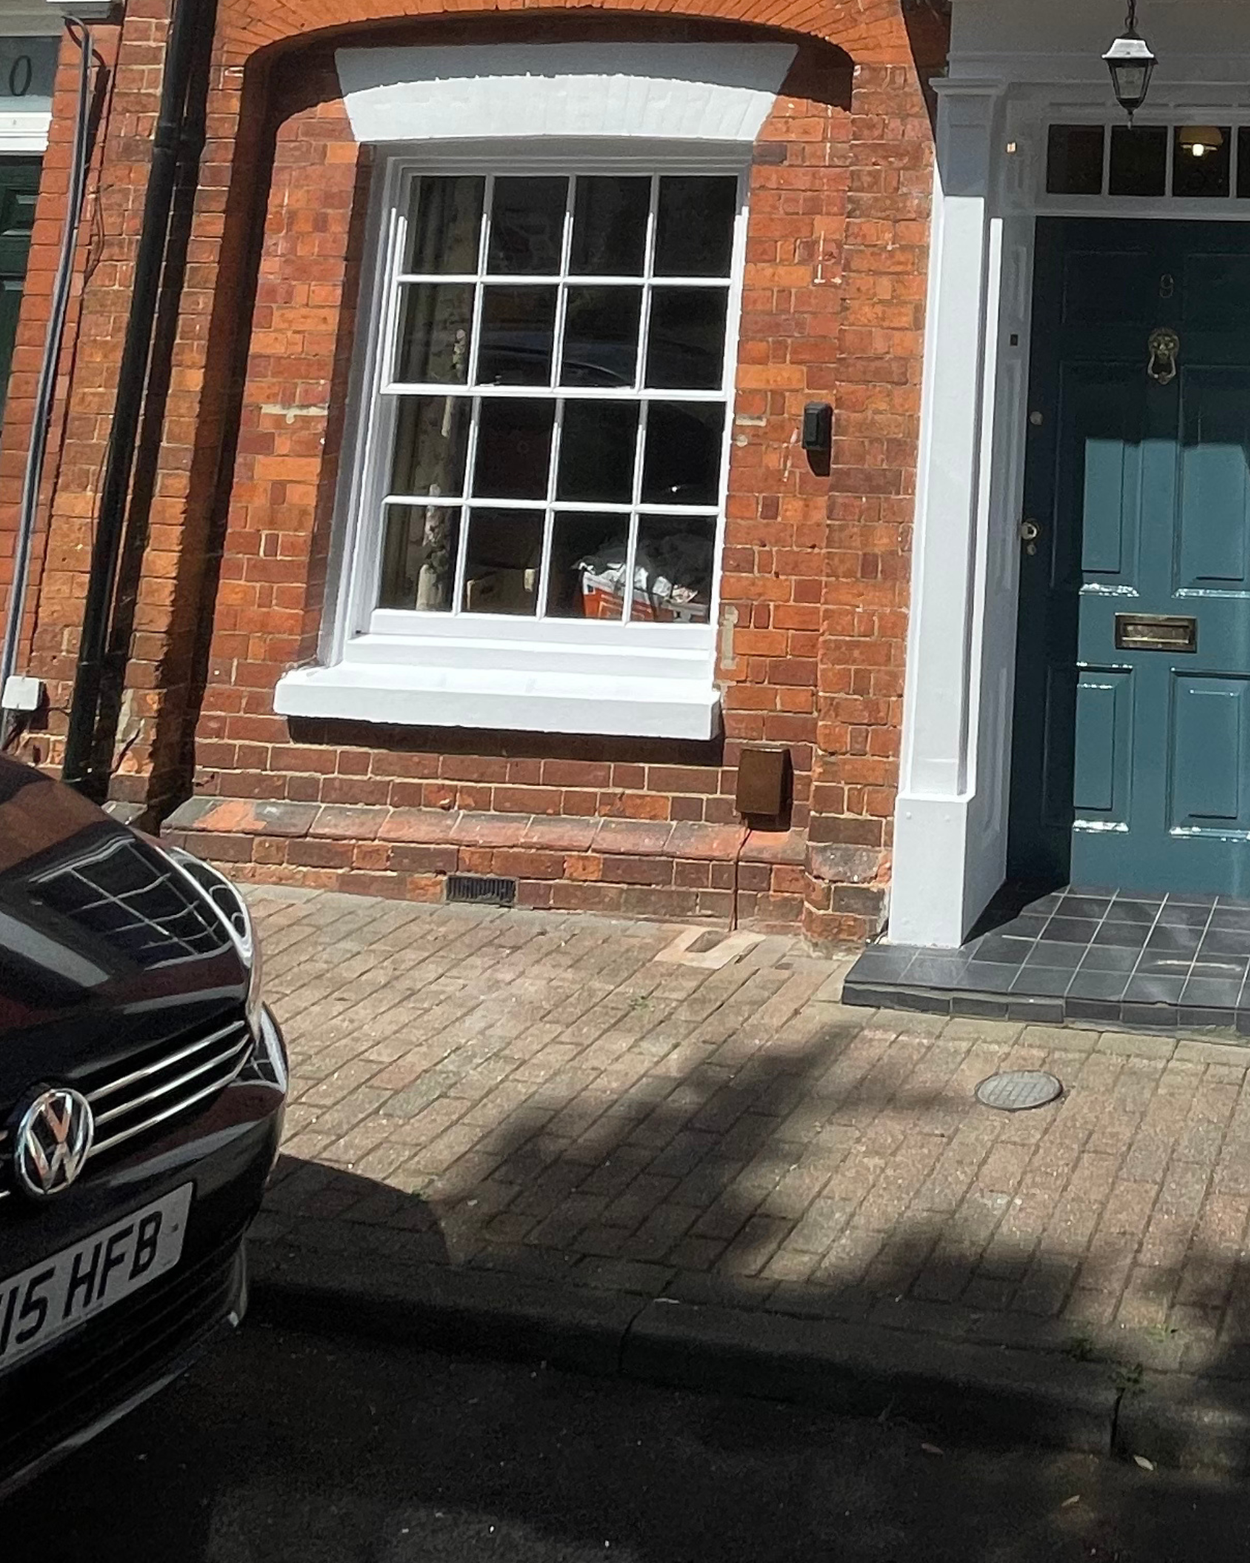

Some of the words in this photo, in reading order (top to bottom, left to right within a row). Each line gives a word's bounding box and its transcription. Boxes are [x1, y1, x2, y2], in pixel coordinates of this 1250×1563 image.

[1160, 274, 1174, 298] 9
[0, 1266, 56, 1356] 15
[62, 1211, 163, 1319] HFB
